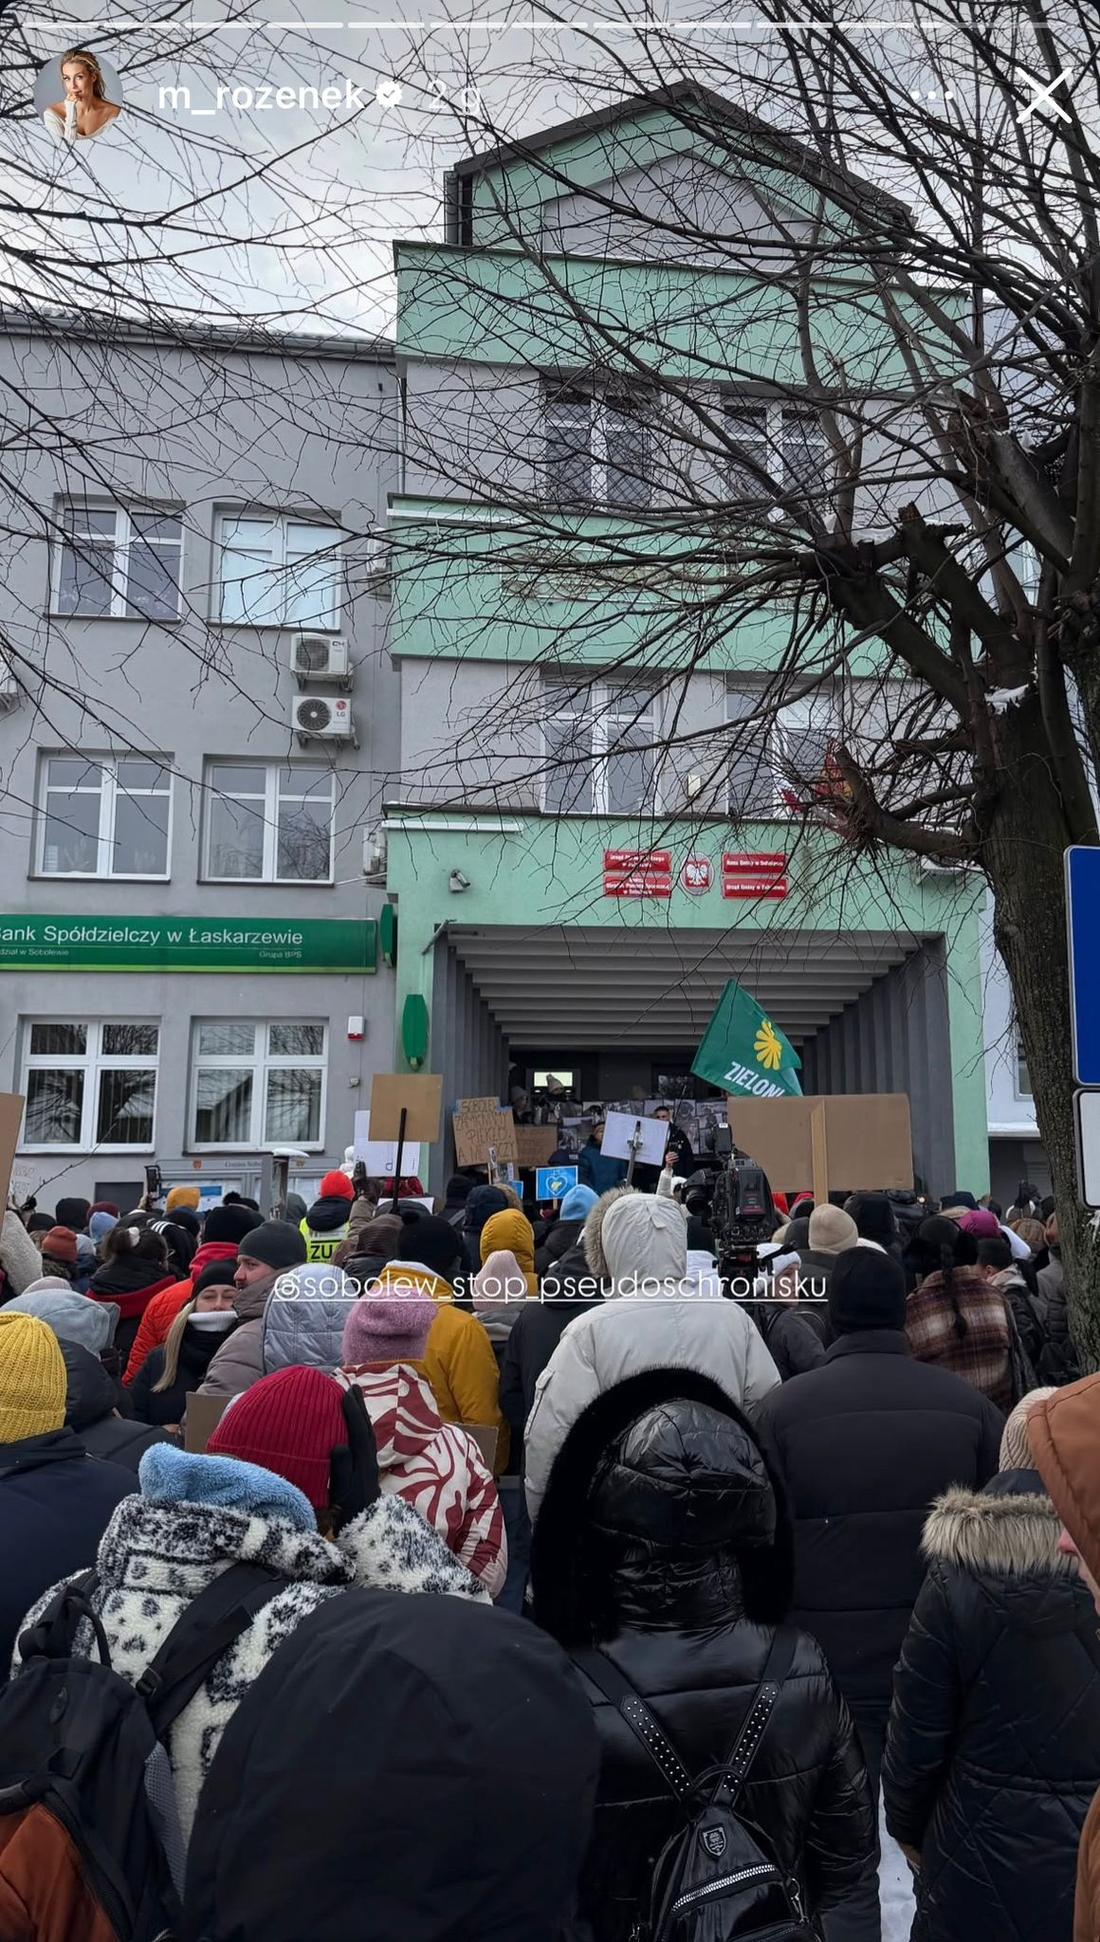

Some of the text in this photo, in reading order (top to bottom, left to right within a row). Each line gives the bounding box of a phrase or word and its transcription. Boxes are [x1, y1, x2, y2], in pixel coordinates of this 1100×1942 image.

[0, 925, 303, 946] ank Spółdzielczy w Łaskarzewie
